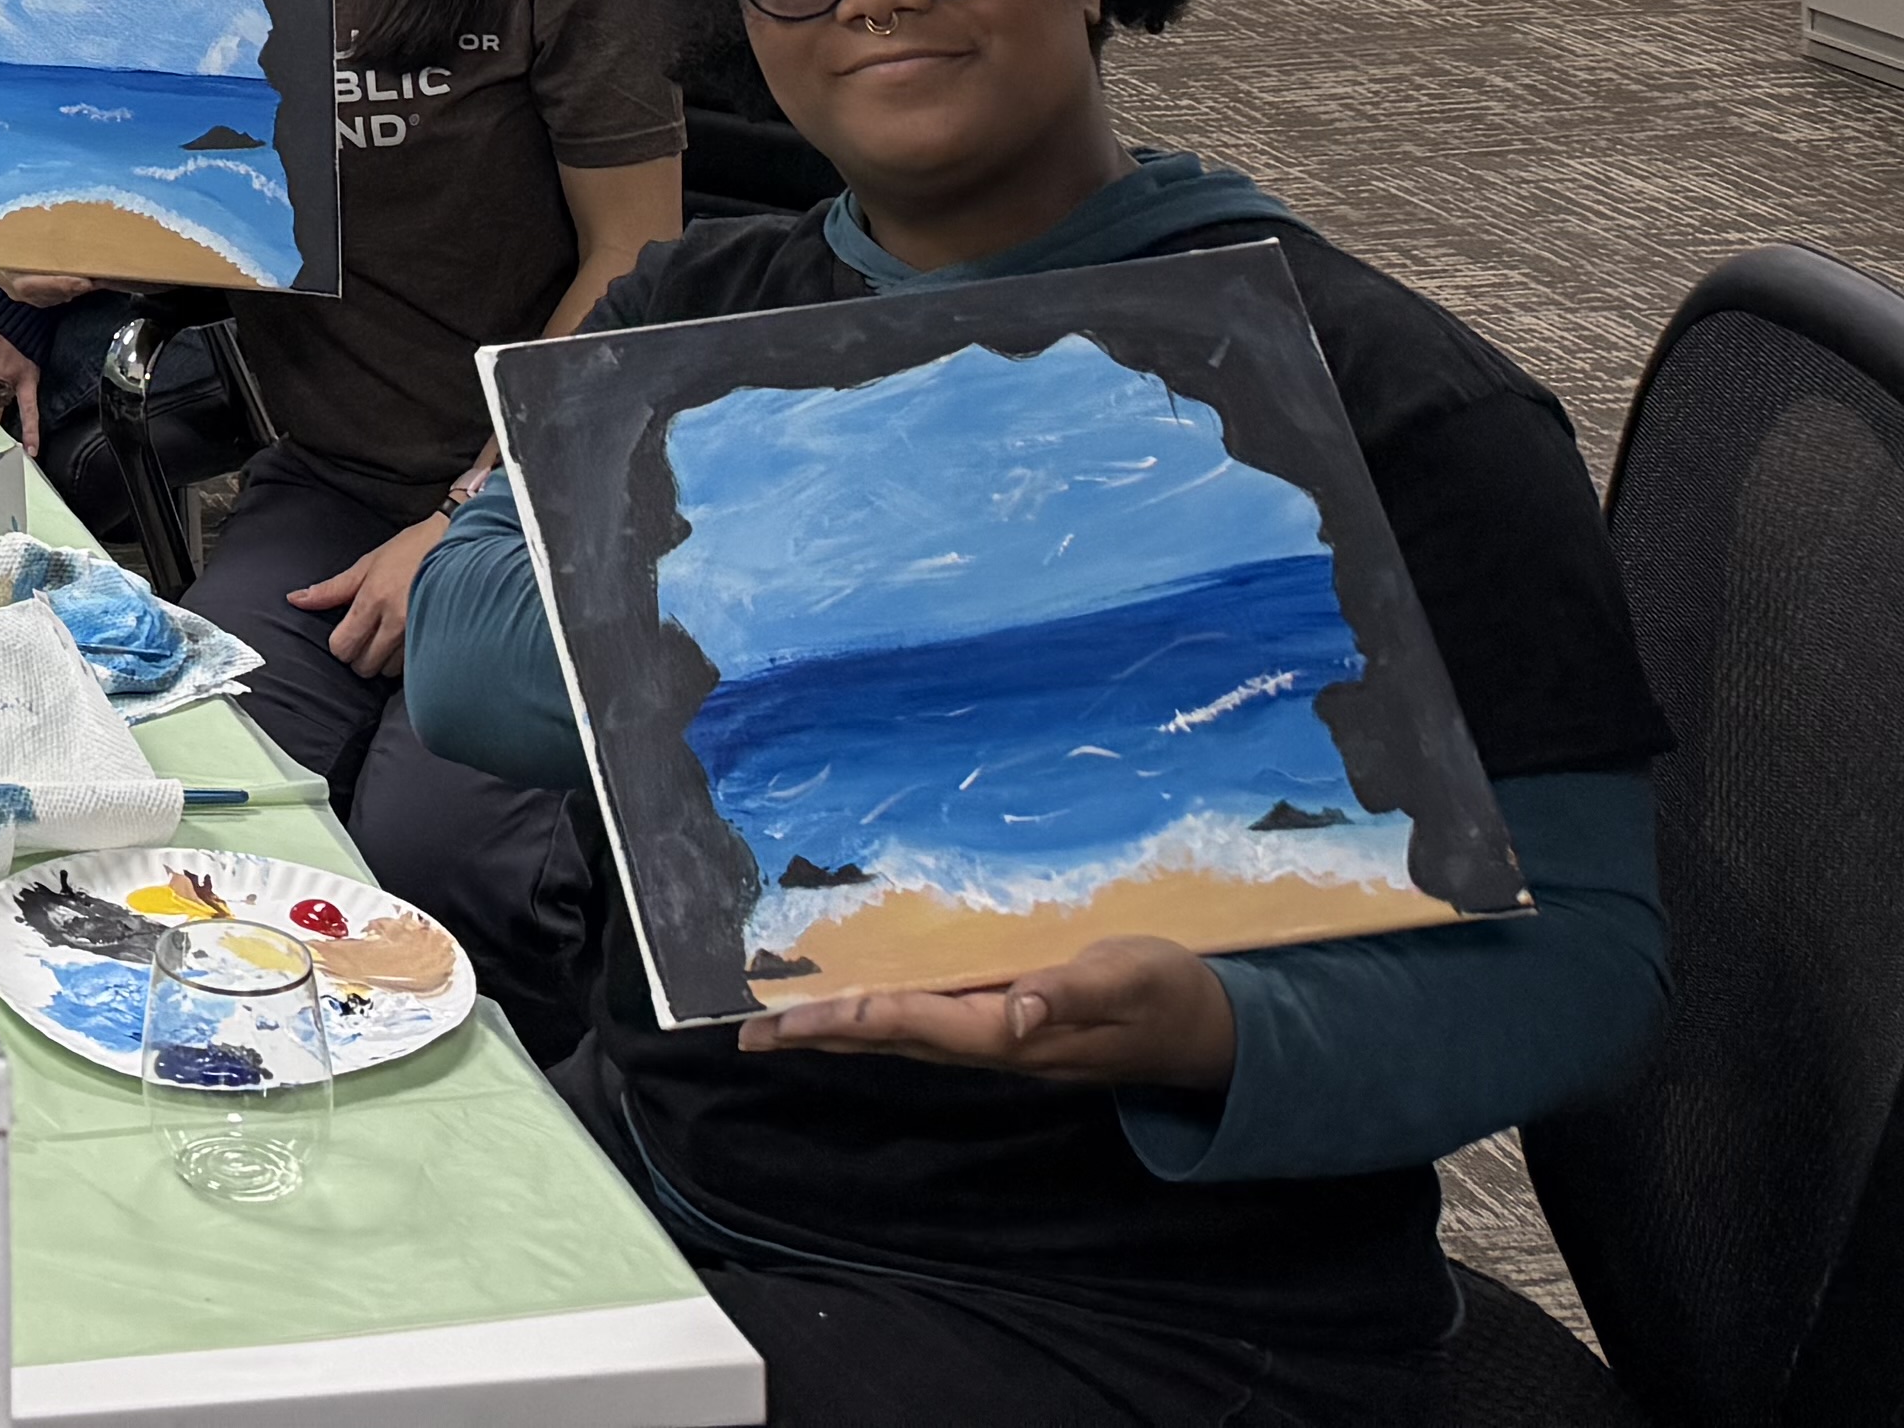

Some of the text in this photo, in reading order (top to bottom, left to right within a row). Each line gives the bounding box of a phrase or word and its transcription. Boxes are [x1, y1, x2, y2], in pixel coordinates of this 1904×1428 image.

[458, 33, 501, 52] OR
[335, 66, 453, 104] BLIC
[337, 114, 408, 149] ND
